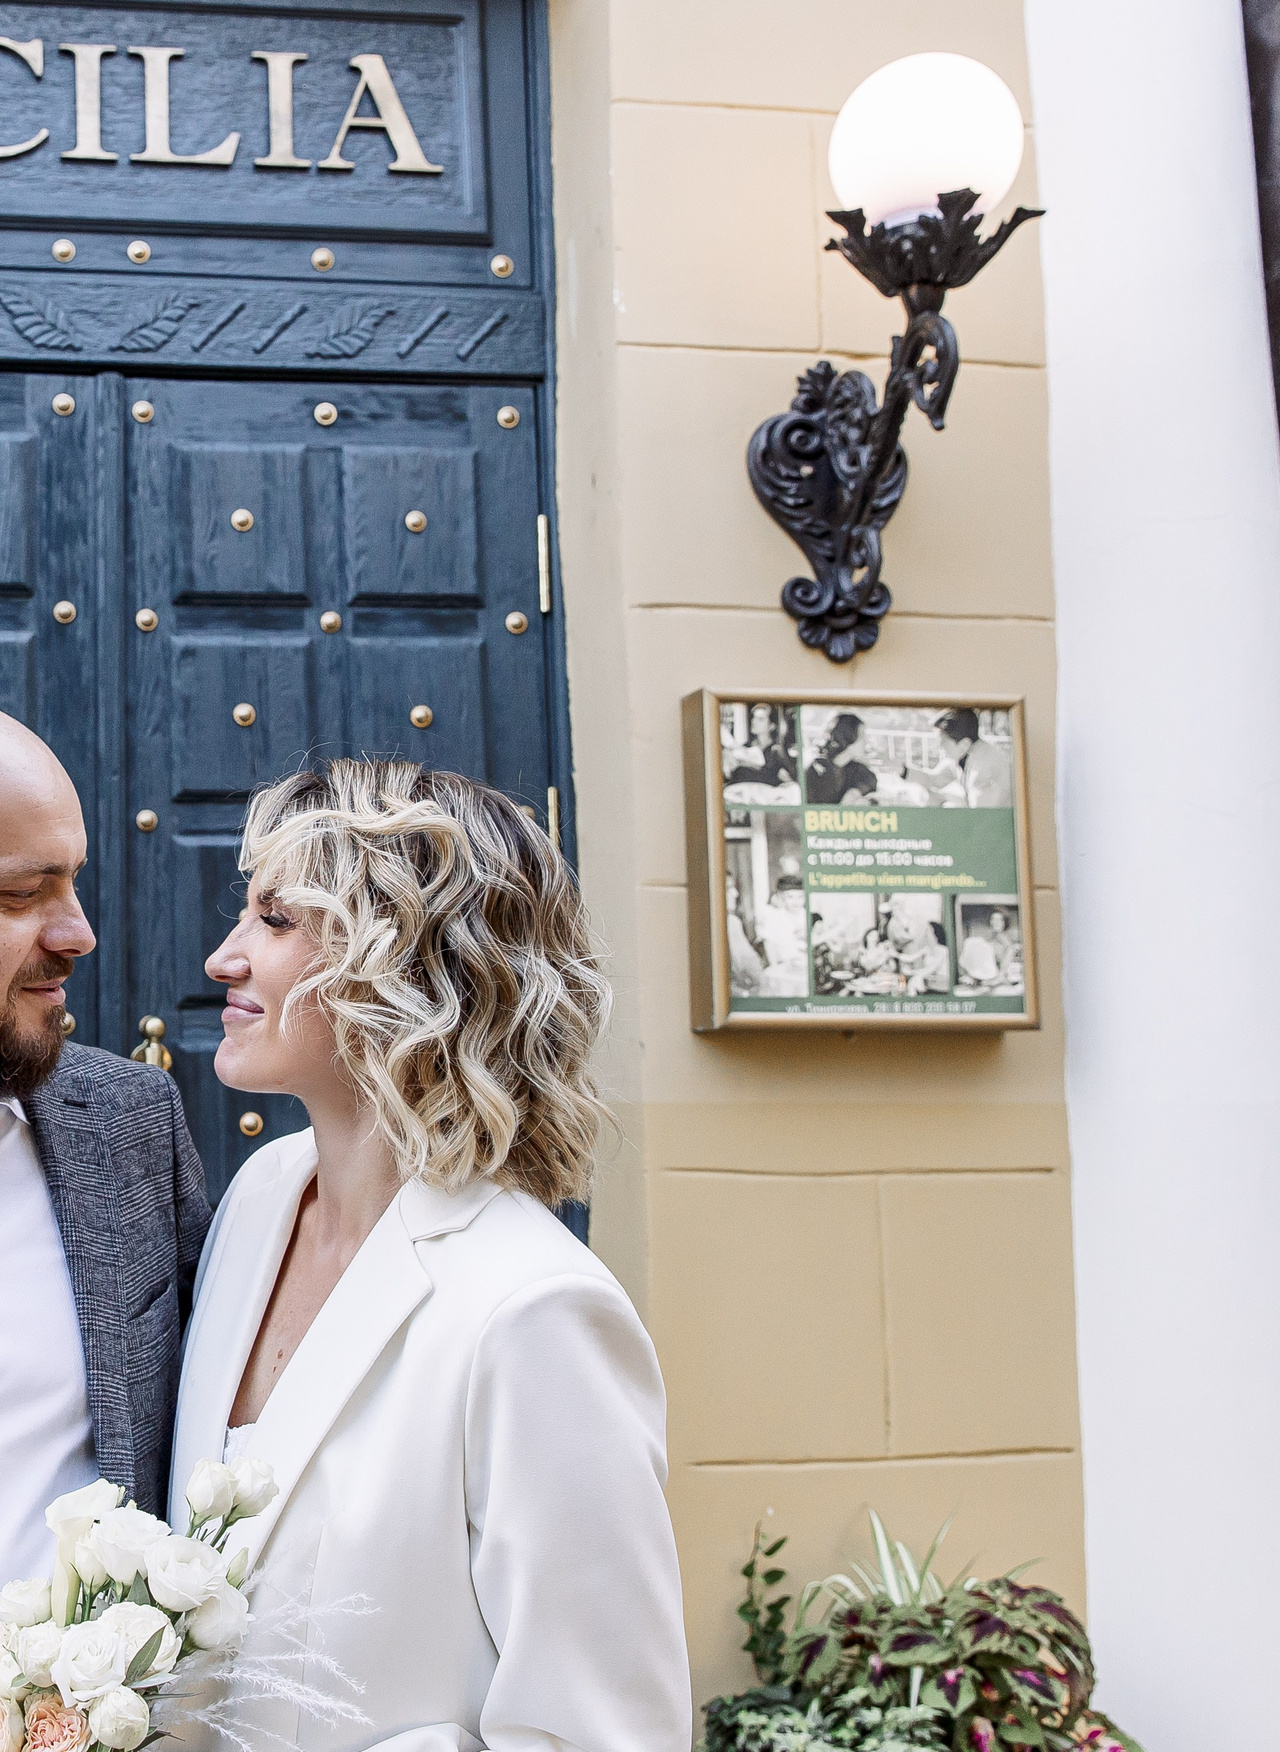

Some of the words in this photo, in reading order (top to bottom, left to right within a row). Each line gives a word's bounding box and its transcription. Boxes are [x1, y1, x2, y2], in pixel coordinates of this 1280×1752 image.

[805, 810, 898, 833] BRUNCH
[807, 835, 863, 850] Каждые
[807, 854, 818, 865] с
[856, 854, 874, 867] до
[914, 855, 953, 867] часов
